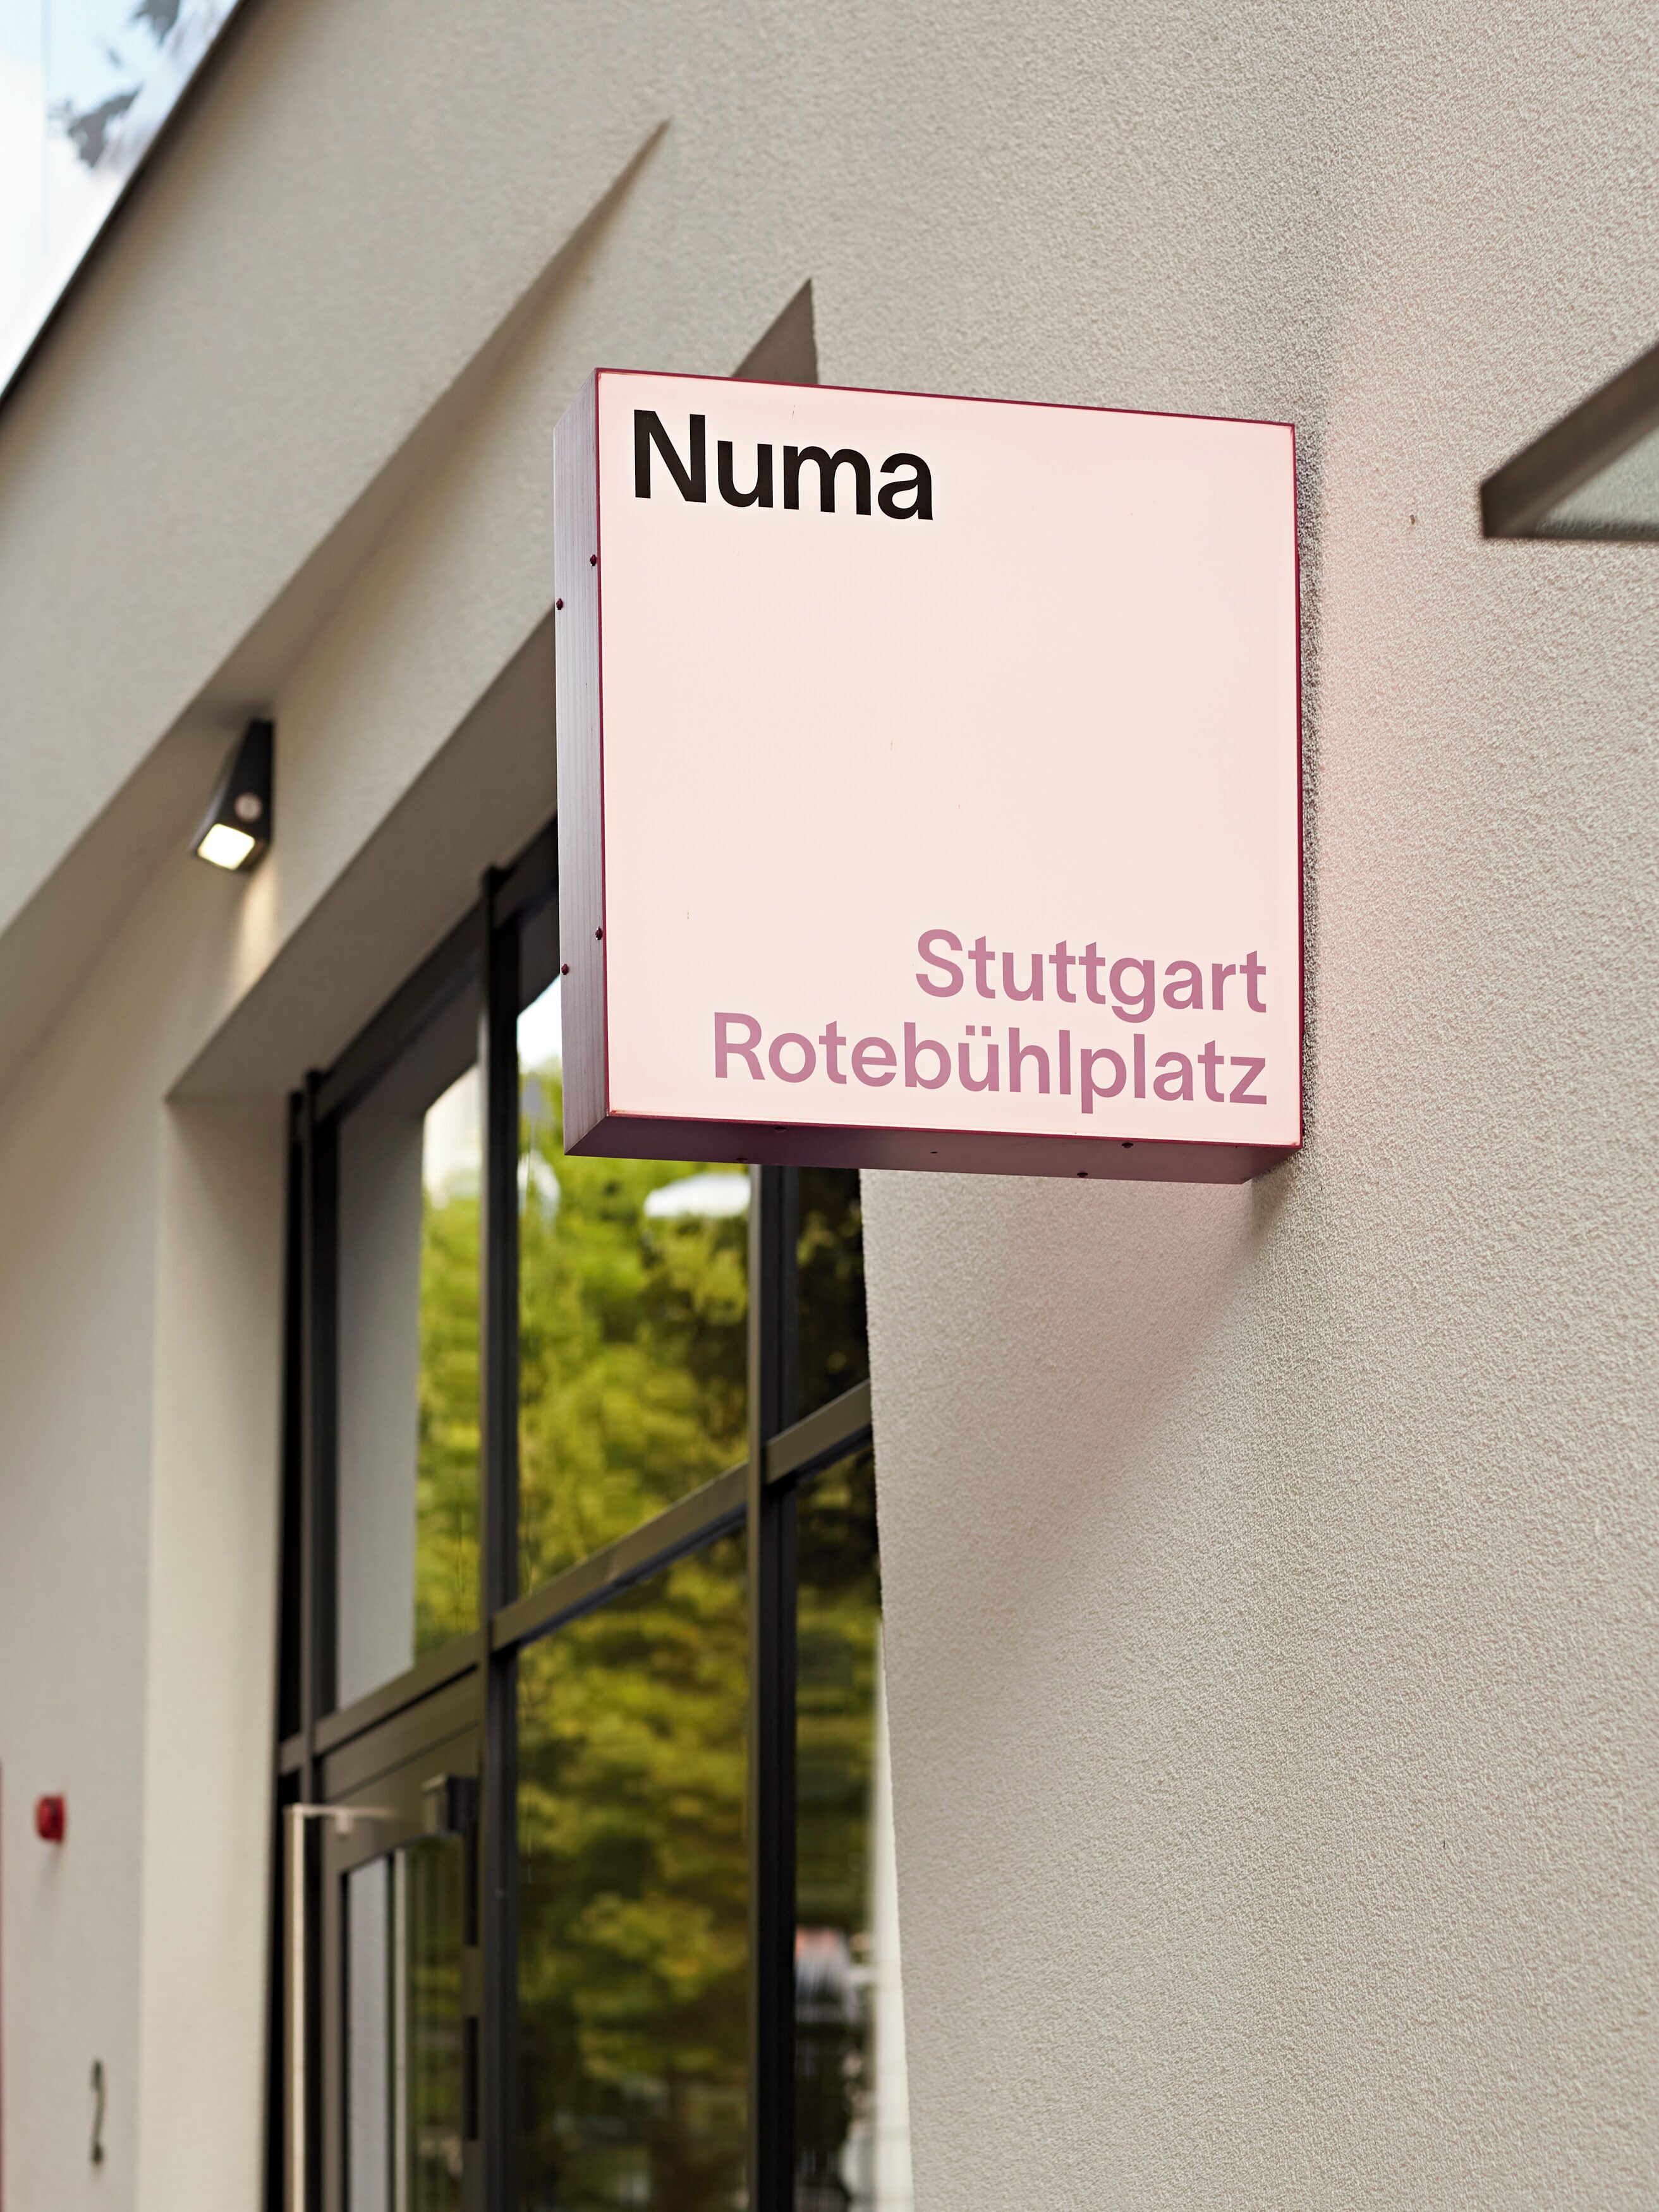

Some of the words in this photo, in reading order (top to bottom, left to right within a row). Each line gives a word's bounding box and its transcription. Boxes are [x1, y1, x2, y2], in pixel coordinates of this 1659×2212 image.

[634, 410, 933, 521] Numa
[916, 928, 1267, 1024] Stuttgart
[715, 1011, 1267, 1115] Rotebühlplatz
